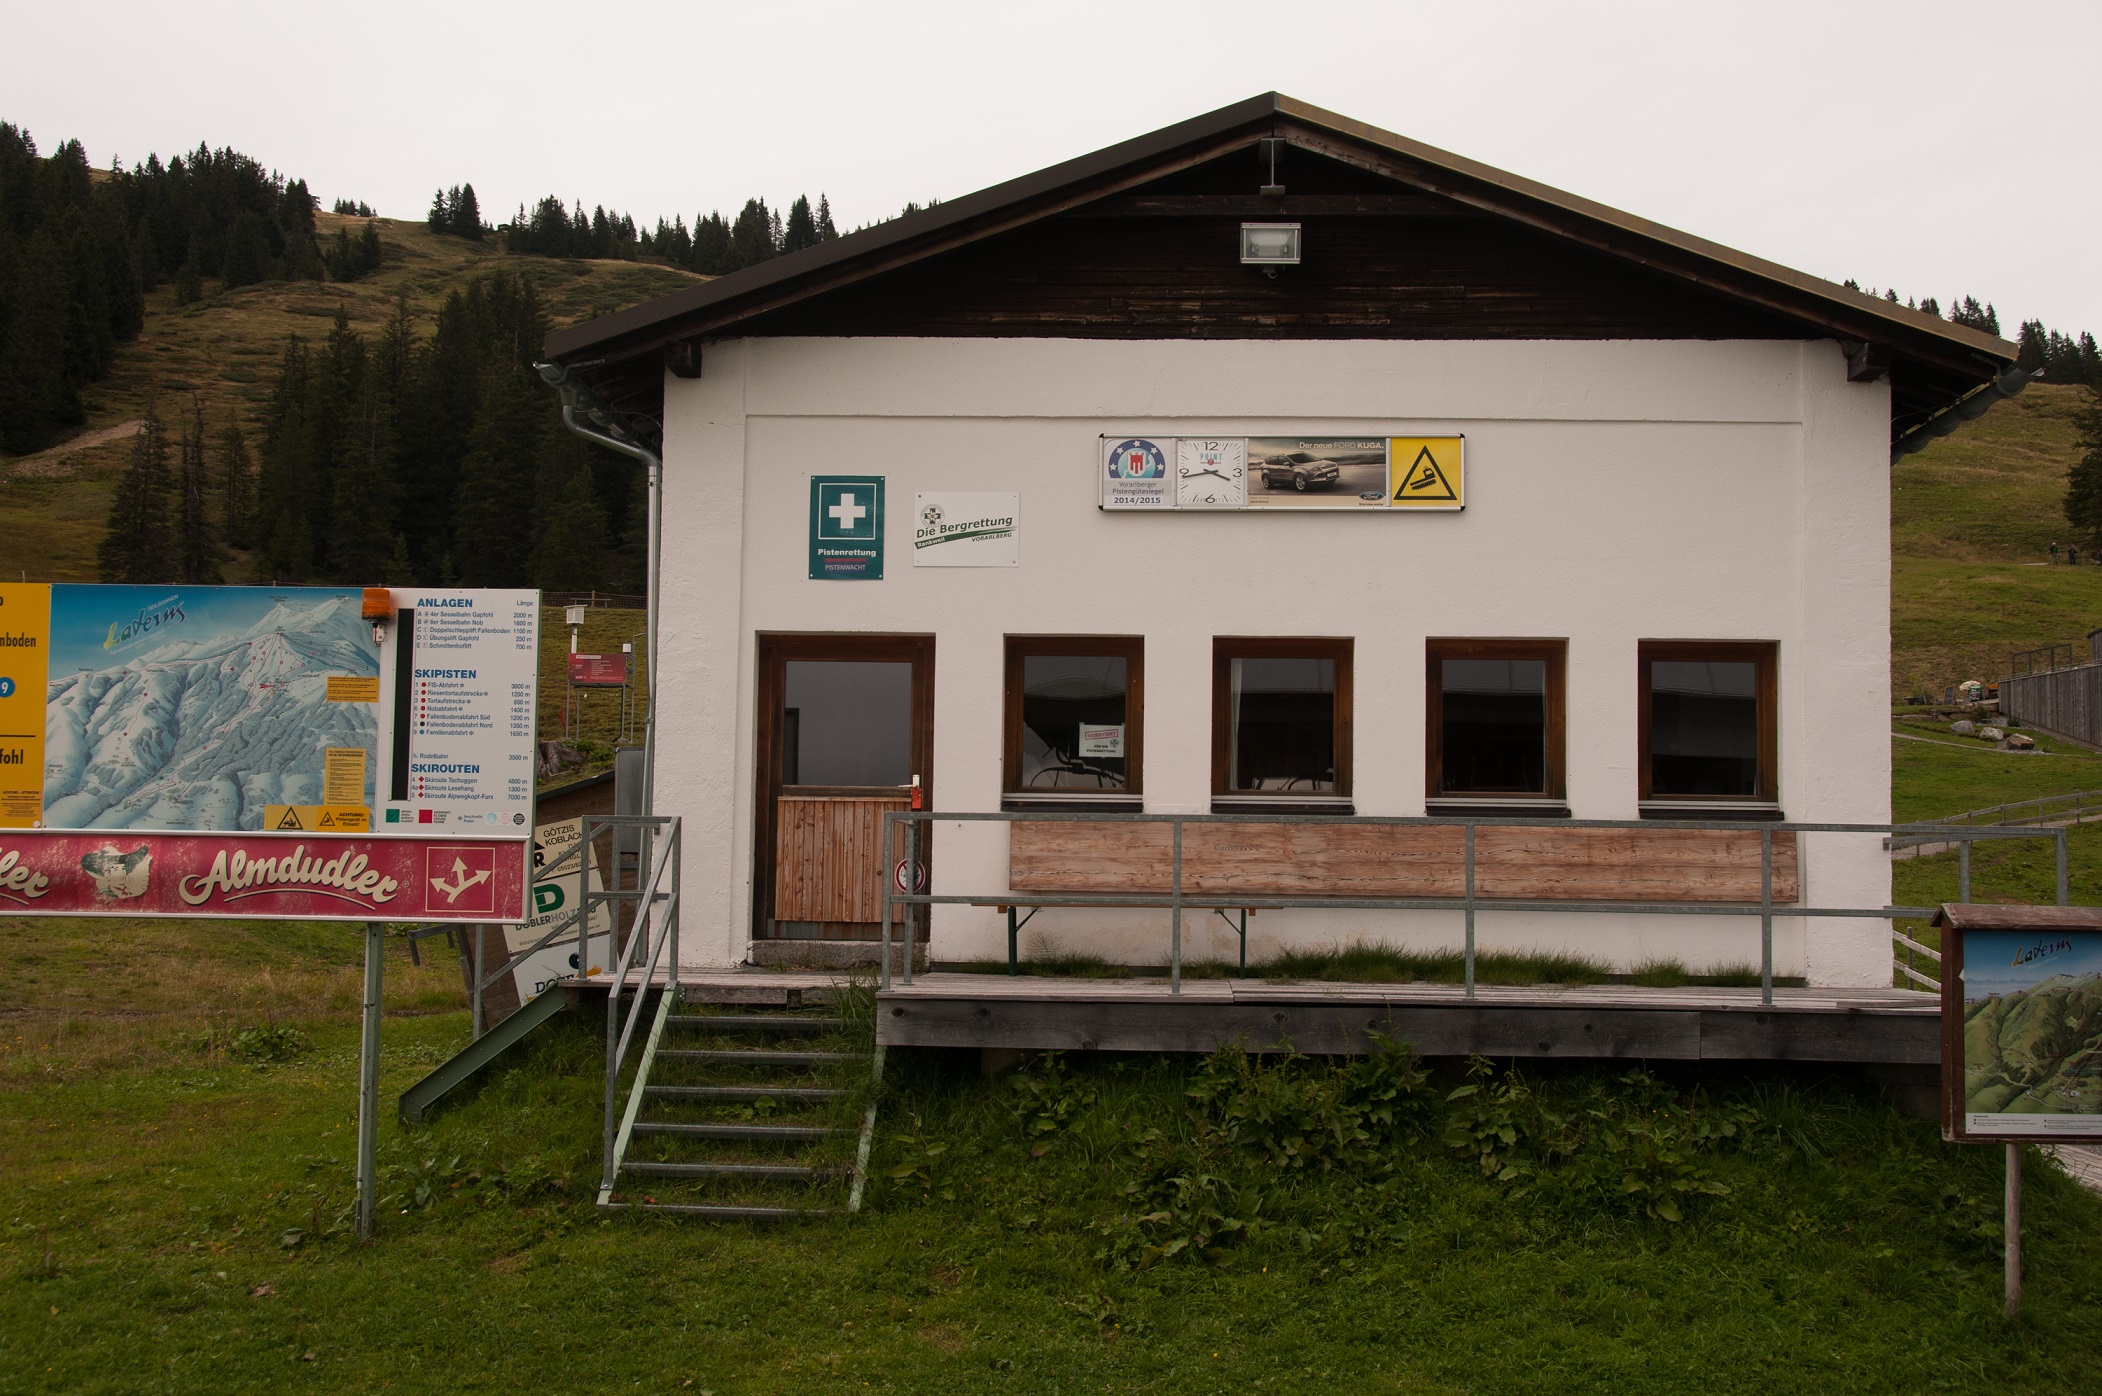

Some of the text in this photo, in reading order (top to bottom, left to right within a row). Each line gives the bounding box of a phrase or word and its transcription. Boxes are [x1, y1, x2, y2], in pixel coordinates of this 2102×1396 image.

[1203, 442, 1218, 450] 12
[1179, 468, 1189, 477] 9
[1233, 468, 1242, 477] 3
[1205, 494, 1215, 503] 6
[916, 517, 1012, 538] Die Bergrettung
[971, 533, 1012, 542] VORARLBERG
[917, 537, 945, 548] Rankweil
[818, 548, 876, 557] Pistenrettung
[417, 599, 473, 607] ANLAGEN
[430, 634, 457, 642] Übungslift
[414, 669, 476, 678] SKIPISTEN
[1, 682, 9, 694] 9
[411, 764, 480, 773] SKIROUTEN
[543, 824, 575, 838] GÖTZIS
[179, 845, 399, 905] Almdudler
